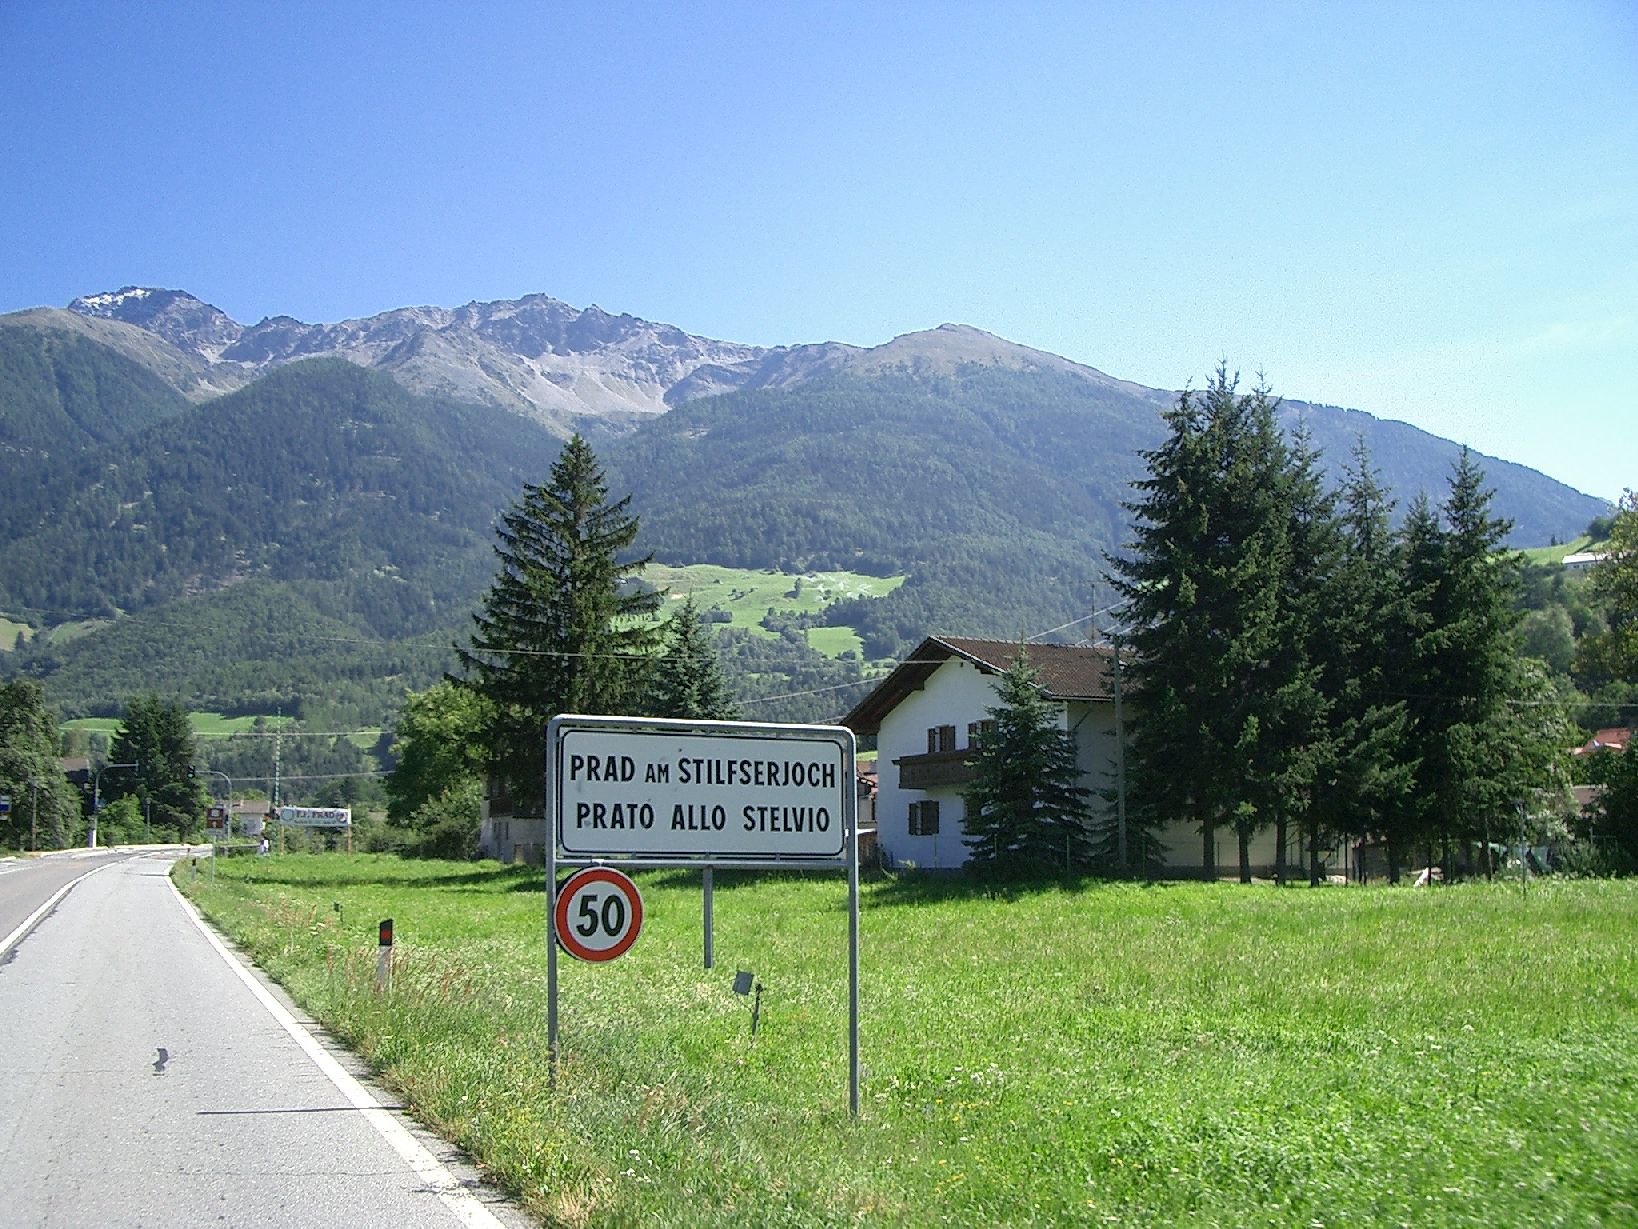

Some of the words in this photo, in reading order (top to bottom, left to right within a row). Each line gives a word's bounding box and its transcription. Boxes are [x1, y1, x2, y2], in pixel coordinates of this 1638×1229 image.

[570, 754, 636, 782] PRAD
[644, 763, 670, 784] AM
[678, 757, 836, 789] STILFSERJOCH
[576, 802, 655, 830] PRATO
[671, 803, 726, 831] ALLO
[743, 805, 830, 833] STELVIO
[575, 894, 625, 937] 50
